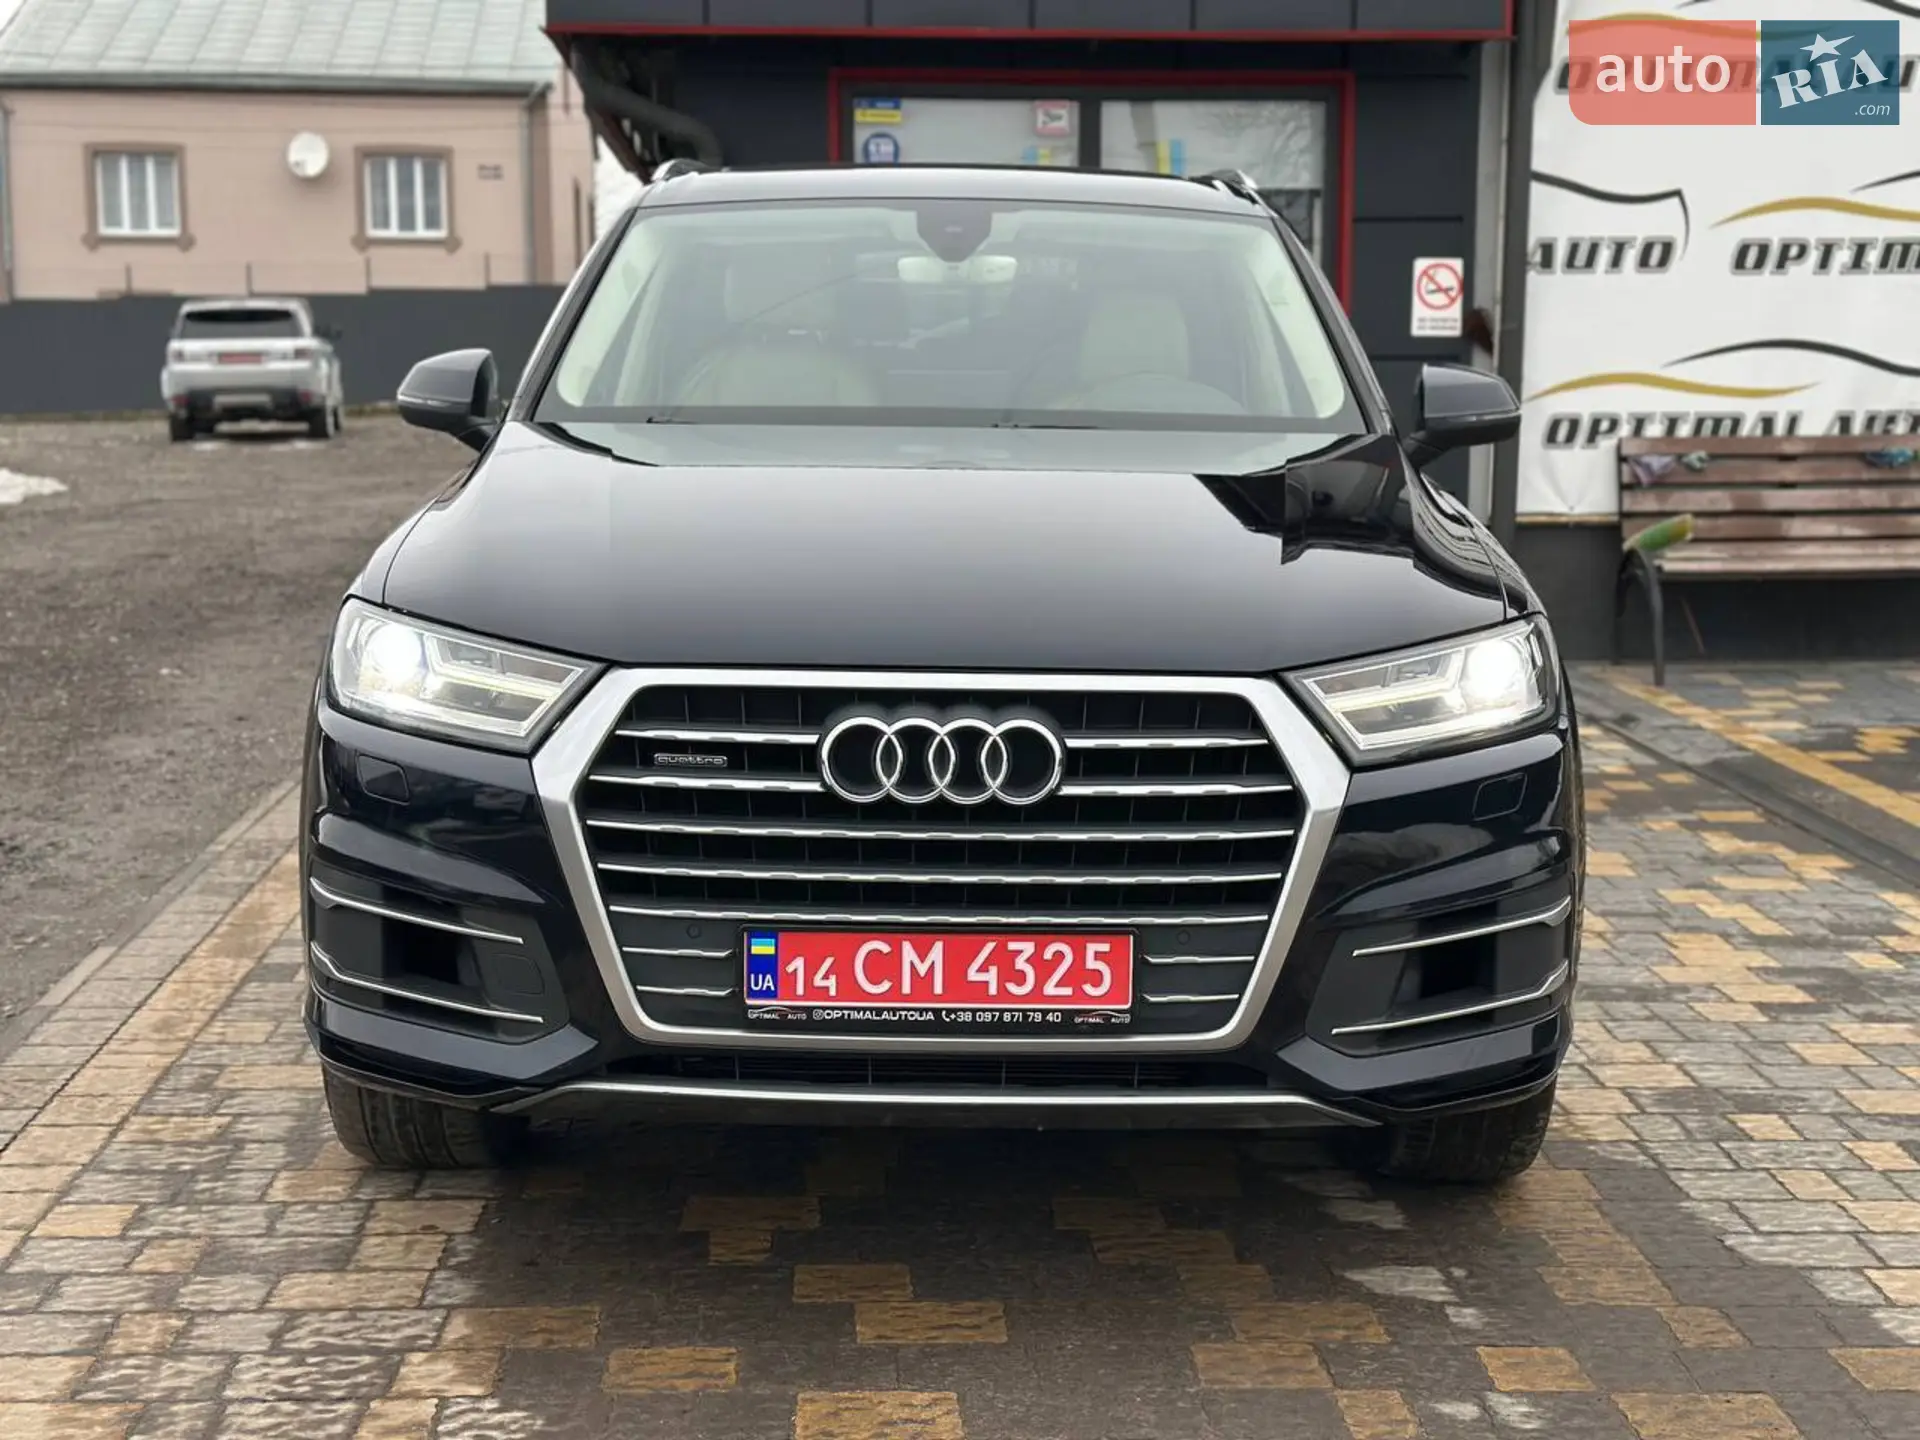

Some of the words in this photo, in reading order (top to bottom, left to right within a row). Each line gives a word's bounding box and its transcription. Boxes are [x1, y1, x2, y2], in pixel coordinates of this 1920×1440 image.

[1528, 235, 1678, 275] AUTO
[657, 756, 724, 765] quattro
[785, 956, 838, 996] 14
[854, 940, 944, 996] CM
[966, 940, 1112, 997] 4325
[750, 974, 776, 992] UA
[950, 1011, 972, 1022] +38
[975, 1012, 1000, 1022] 097
[1003, 1012, 1023, 1022] 871
[1027, 1012, 1043, 1022] 79
[1045, 1012, 1062, 1023] 40
